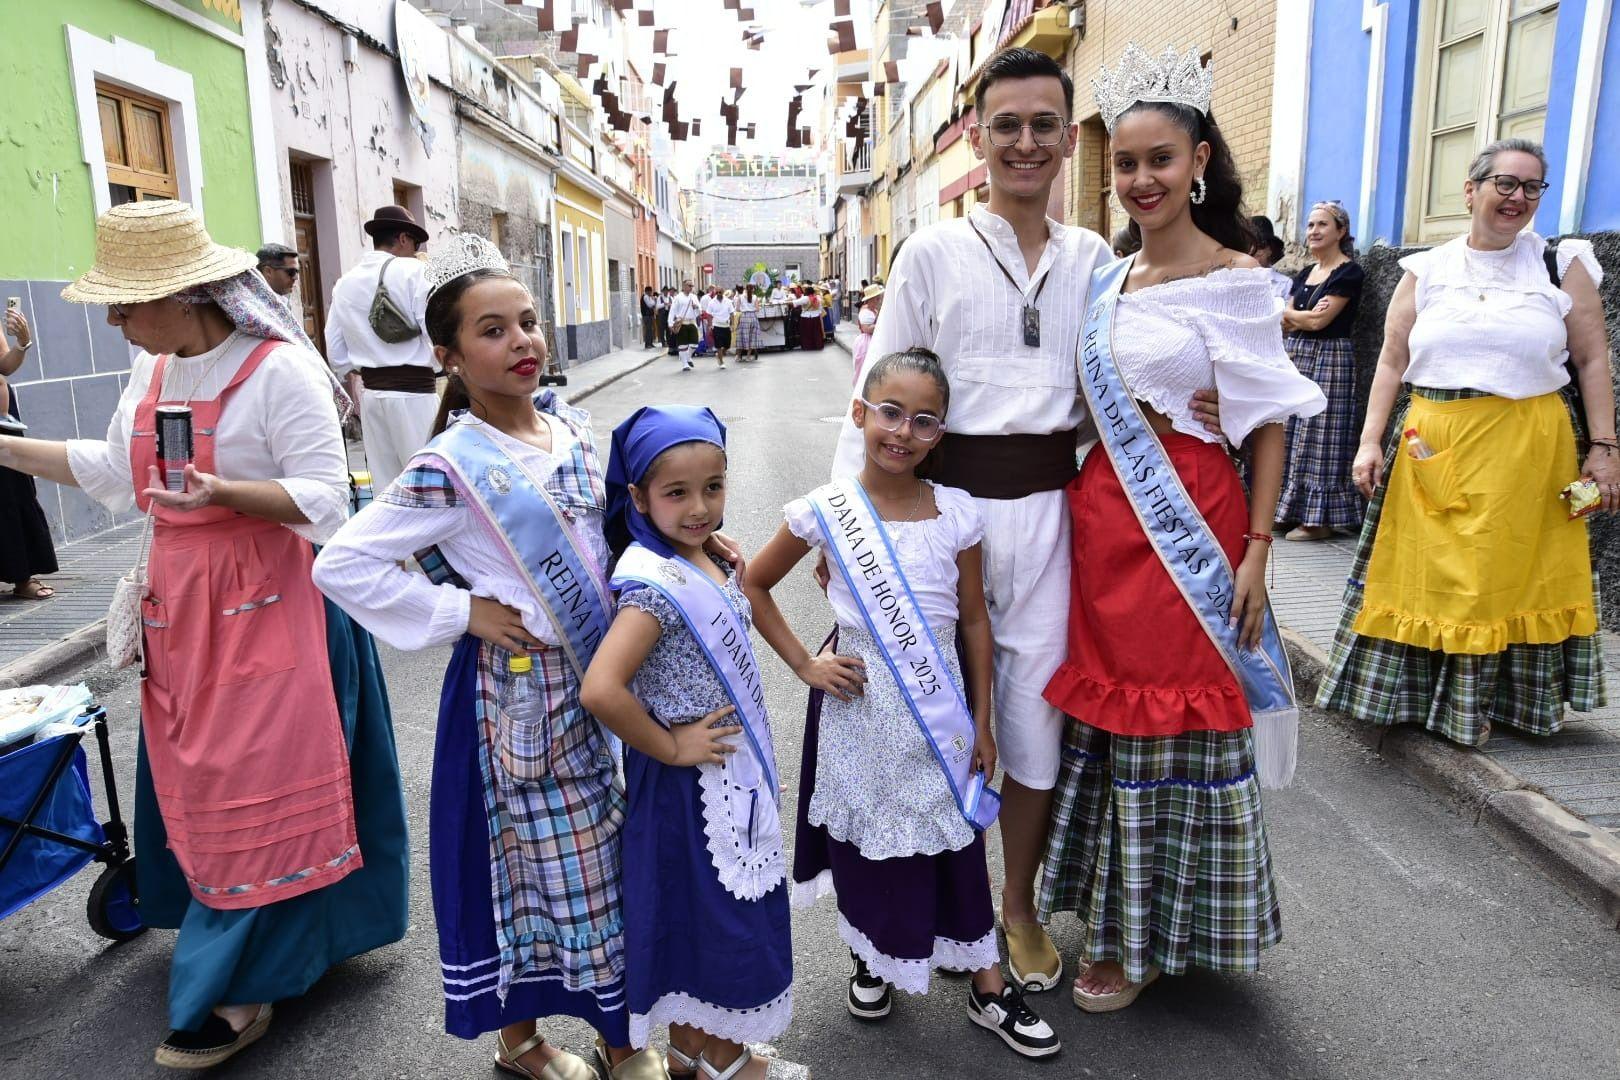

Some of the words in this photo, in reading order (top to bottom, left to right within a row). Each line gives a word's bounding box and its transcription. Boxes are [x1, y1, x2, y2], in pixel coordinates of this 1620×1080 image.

[1084, 328, 1109, 400] REINA
[1103, 401, 1129, 437] DE
[1120, 435, 1156, 483] LAS
[1144, 484, 1210, 575] FIESTAS
[538, 549, 593, 631] REINA
[721, 626, 755, 690] DAMA
[828, 492, 866, 551] DAMA
[856, 550, 882, 580] DE
[870, 580, 917, 651] HONOR
[909, 656, 942, 697] 2025
